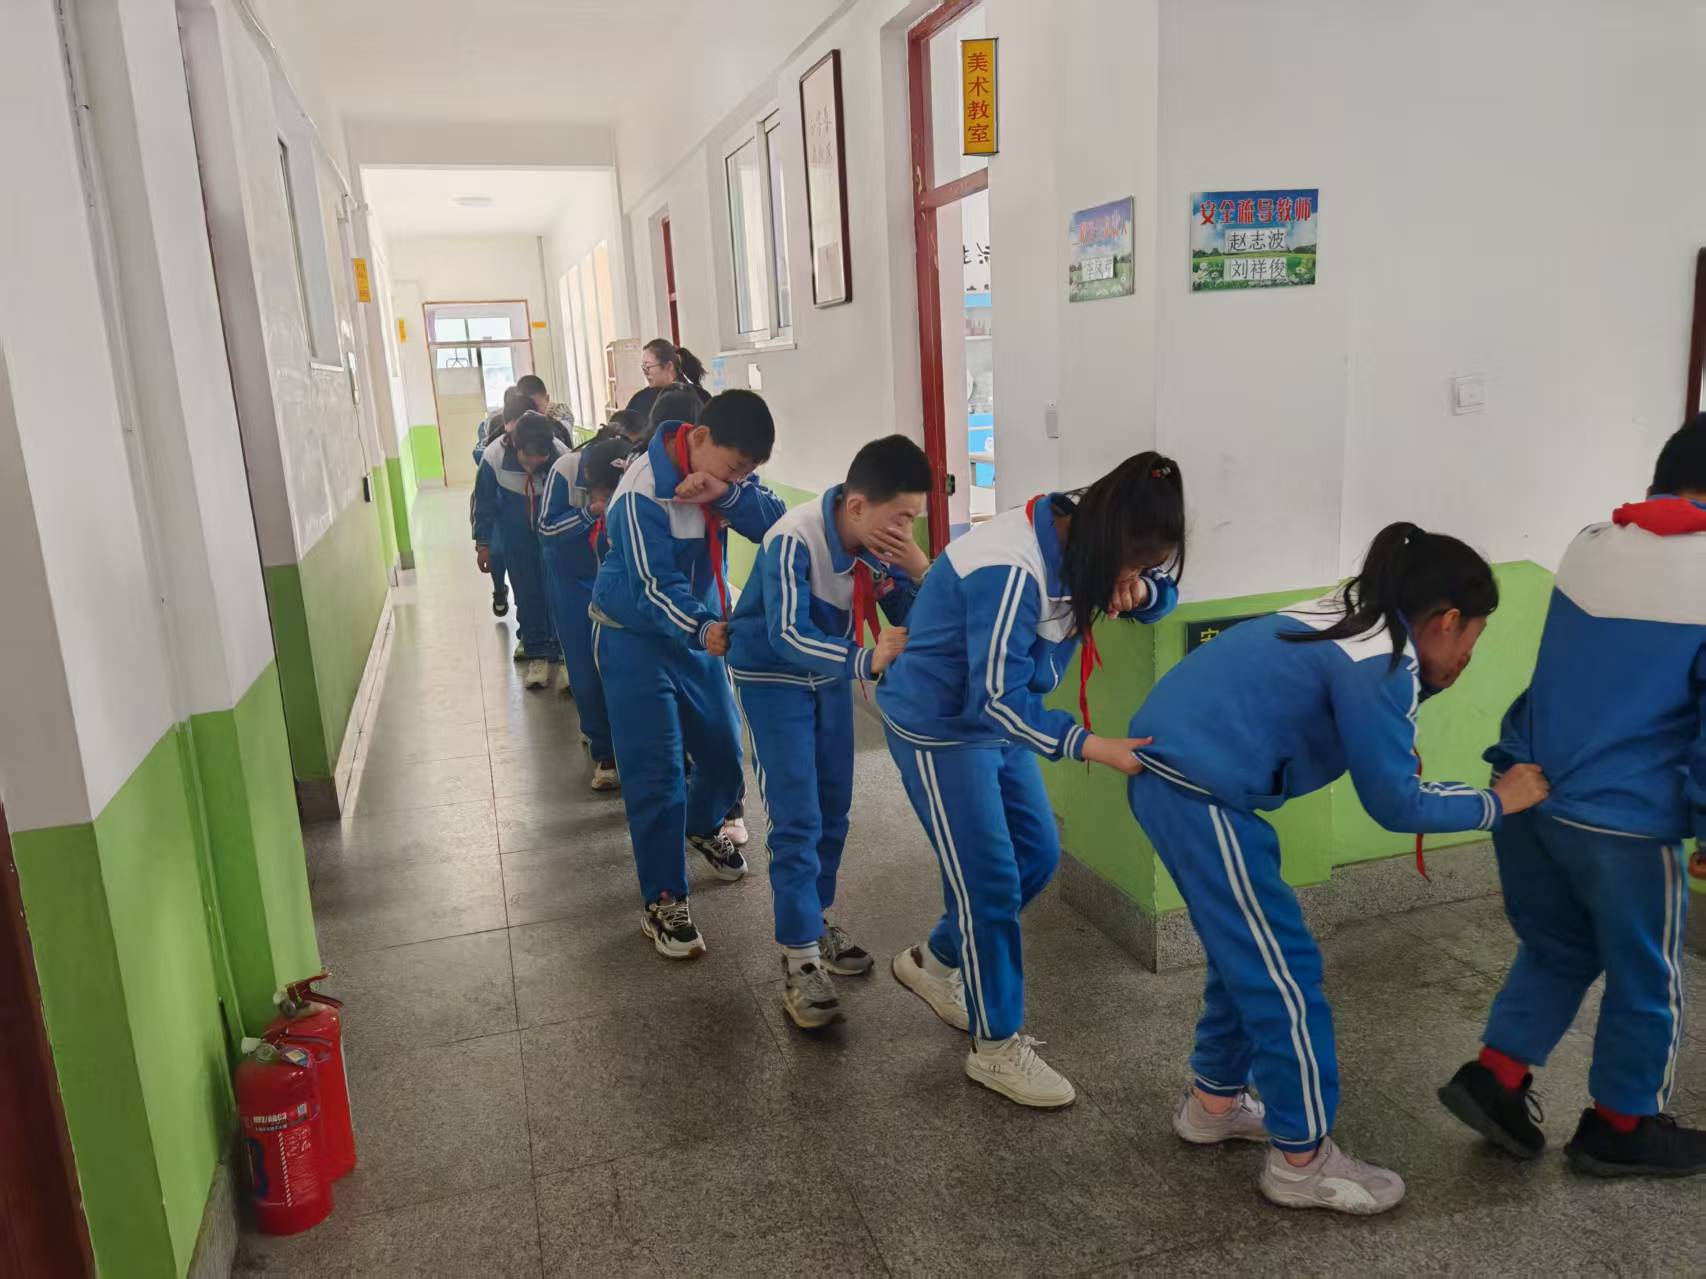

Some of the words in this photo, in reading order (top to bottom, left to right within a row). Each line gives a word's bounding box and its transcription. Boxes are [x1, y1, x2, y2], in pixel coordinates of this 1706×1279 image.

[967, 51, 991, 144] 美术教室
[1199, 197, 1313, 225] 安全疏导教师
[1229, 230, 1285, 252] 赵志波
[1230, 258, 1287, 281] 刘祥俊
